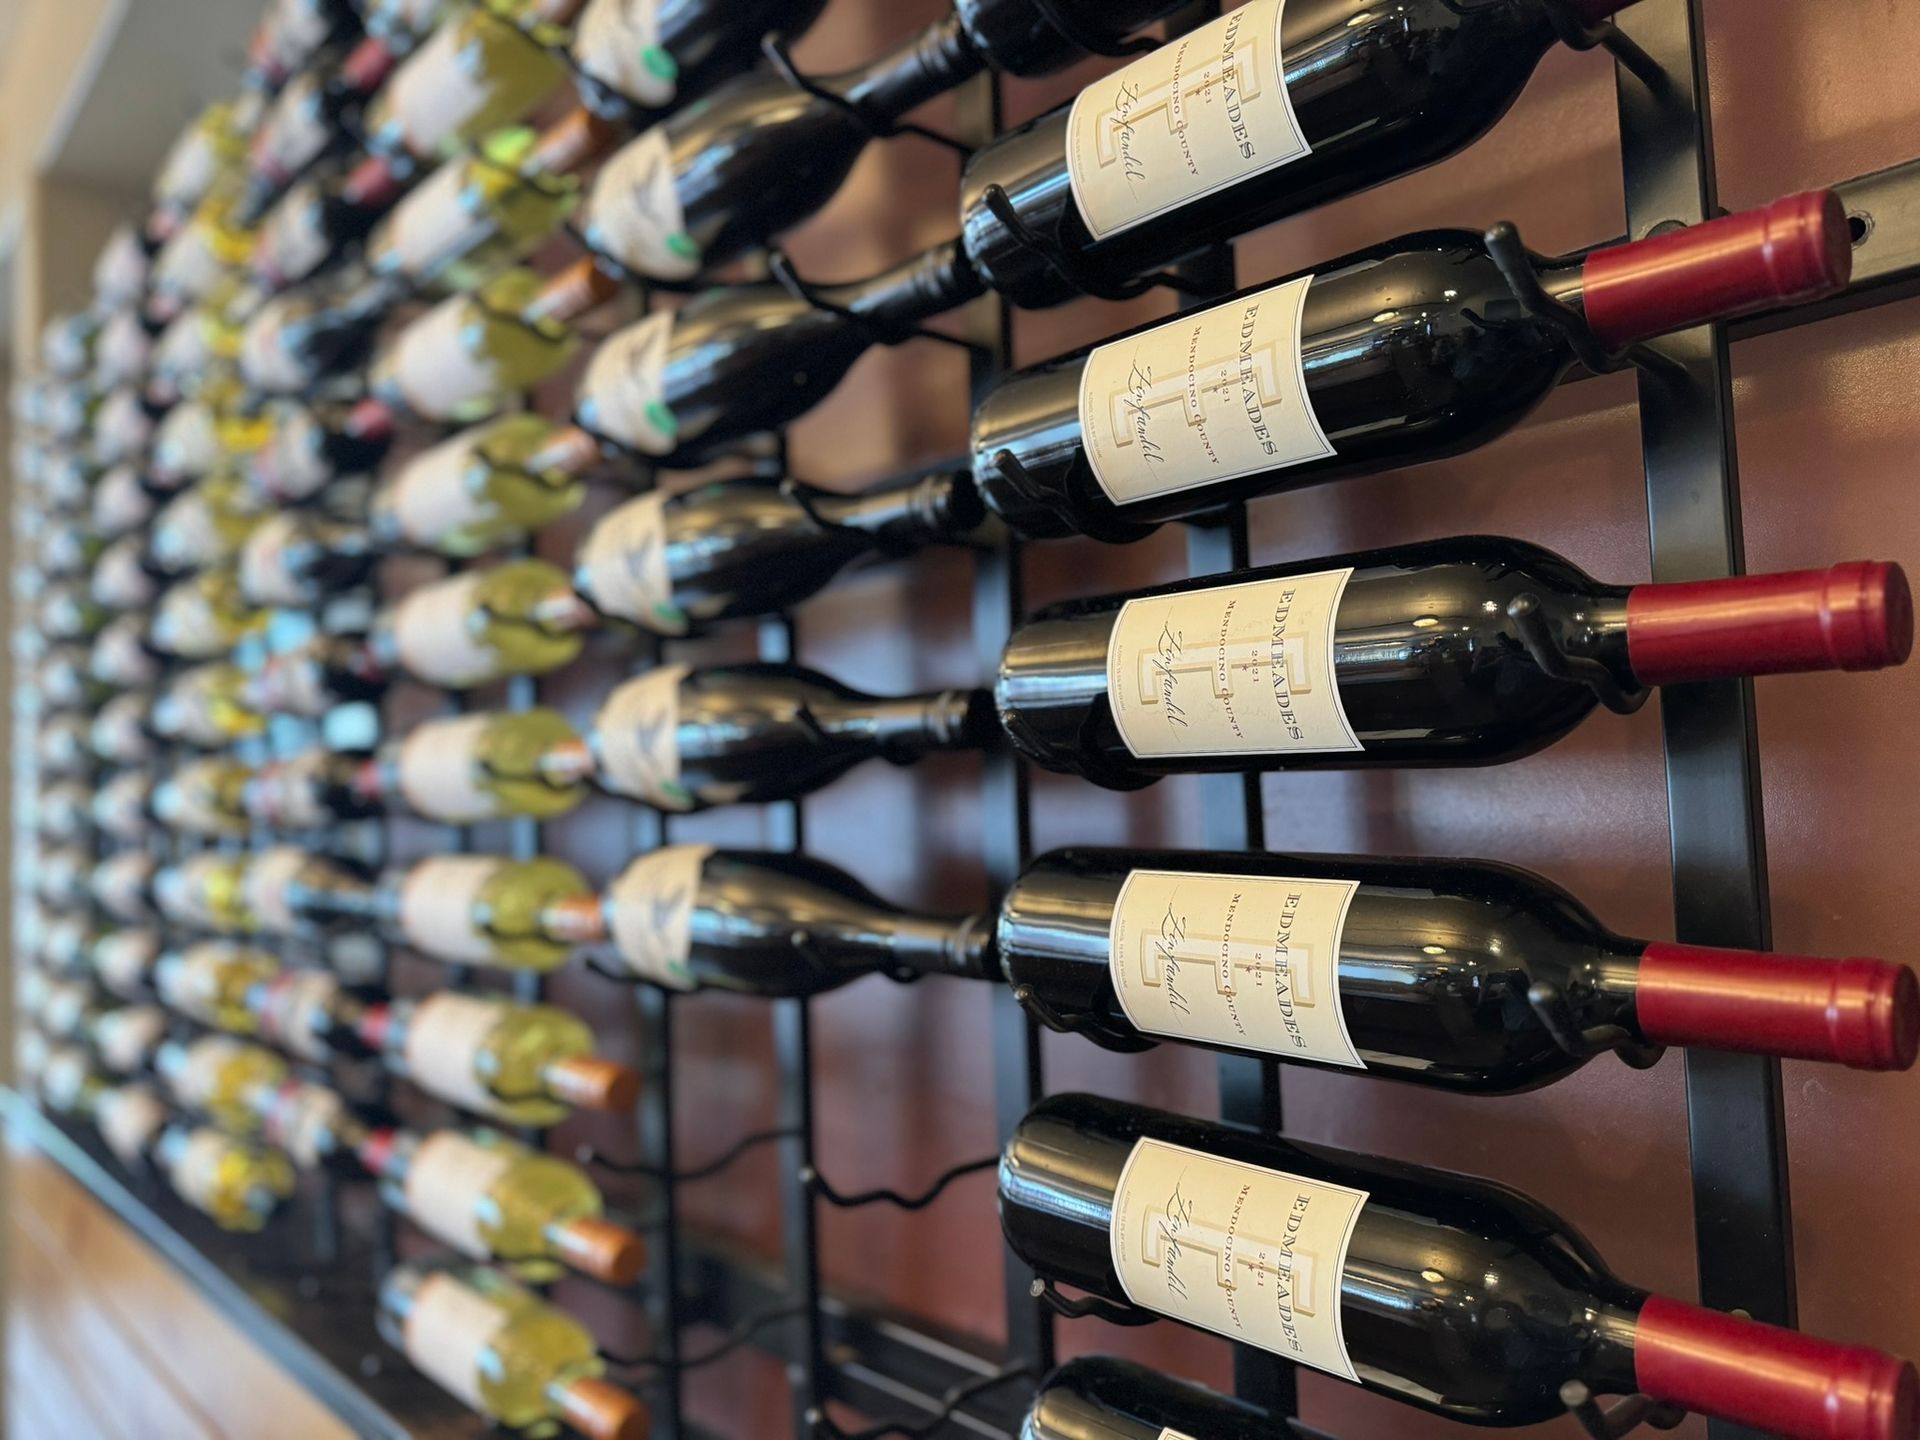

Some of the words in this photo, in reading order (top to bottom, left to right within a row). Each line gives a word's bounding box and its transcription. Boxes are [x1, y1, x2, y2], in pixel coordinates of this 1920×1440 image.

[1172, 40, 1190, 115] MENDOCINO
[1203, 71, 1213, 104] 2021
[1221, 11, 1255, 160] EDMEADES
[1110, 73, 1145, 203] Zinfandel
[1176, 120, 1200, 176] COUNTY
[1188, 326, 1202, 408] MENDOCINO
[1220, 370, 1230, 402] 2021
[1240, 304, 1279, 456] EDMEADES
[1124, 346, 1165, 480] Zinfandel
[1194, 413, 1220, 464] COUNTY
[1152, 608, 1188, 742] Zinfandel
[1216, 600, 1237, 682] MENDOCINO
[1251, 650, 1259, 683] 2021
[1271, 588, 1304, 740] EDMEADES
[1221, 687, 1244, 739] COUNTY
[1155, 886, 1191, 1027] Zinfandel
[1221, 893, 1242, 979] MENDOCINO
[1254, 952, 1263, 987] 2021
[1274, 893, 1307, 1048] EDMEADES
[1224, 984, 1246, 1037] COUNTY
[1158, 1168, 1193, 1307] Zinfandel
[1223, 1184, 1250, 1273] MENDOCINO
[1258, 1252, 1266, 1287] 2021
[1224, 1278, 1242, 1330] COUNTY
[1277, 1193, 1312, 1353] EDMEADES
